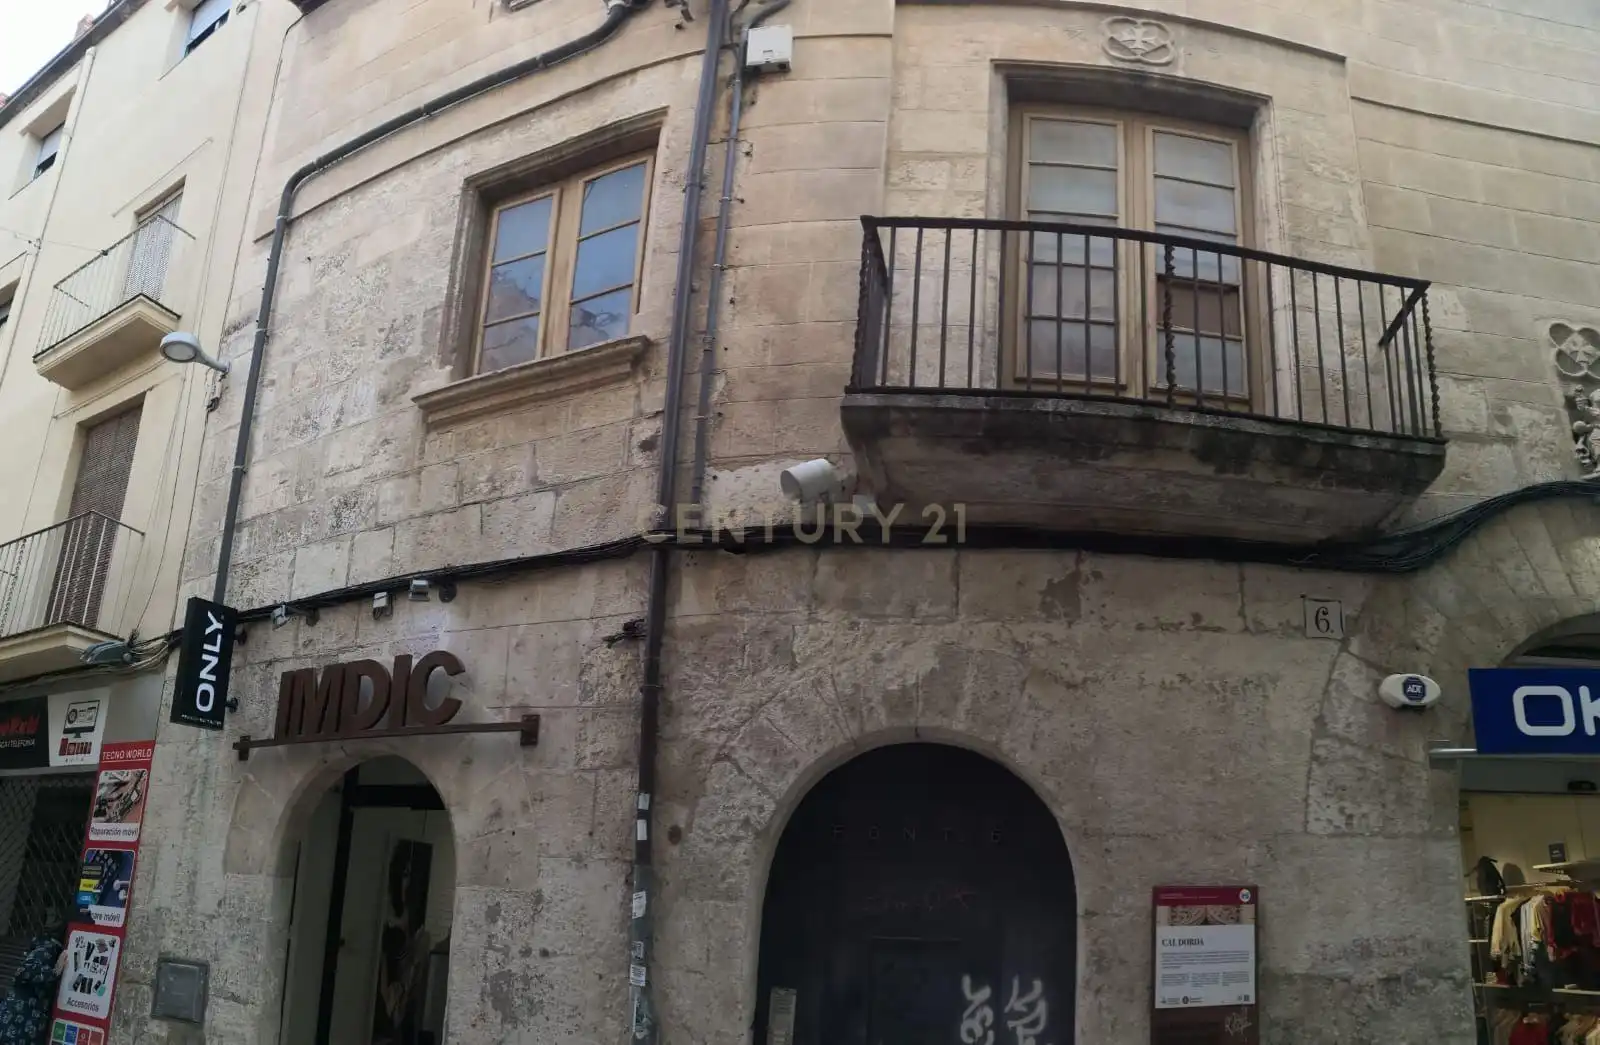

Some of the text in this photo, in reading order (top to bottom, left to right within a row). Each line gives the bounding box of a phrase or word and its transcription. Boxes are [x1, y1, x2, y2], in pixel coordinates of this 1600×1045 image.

[196, 610, 225, 713] ONLY
[274, 650, 466, 742] IMDIC
[102, 748, 152, 760] TECNO WORLD
[66, 996, 100, 1013] Accesorios
